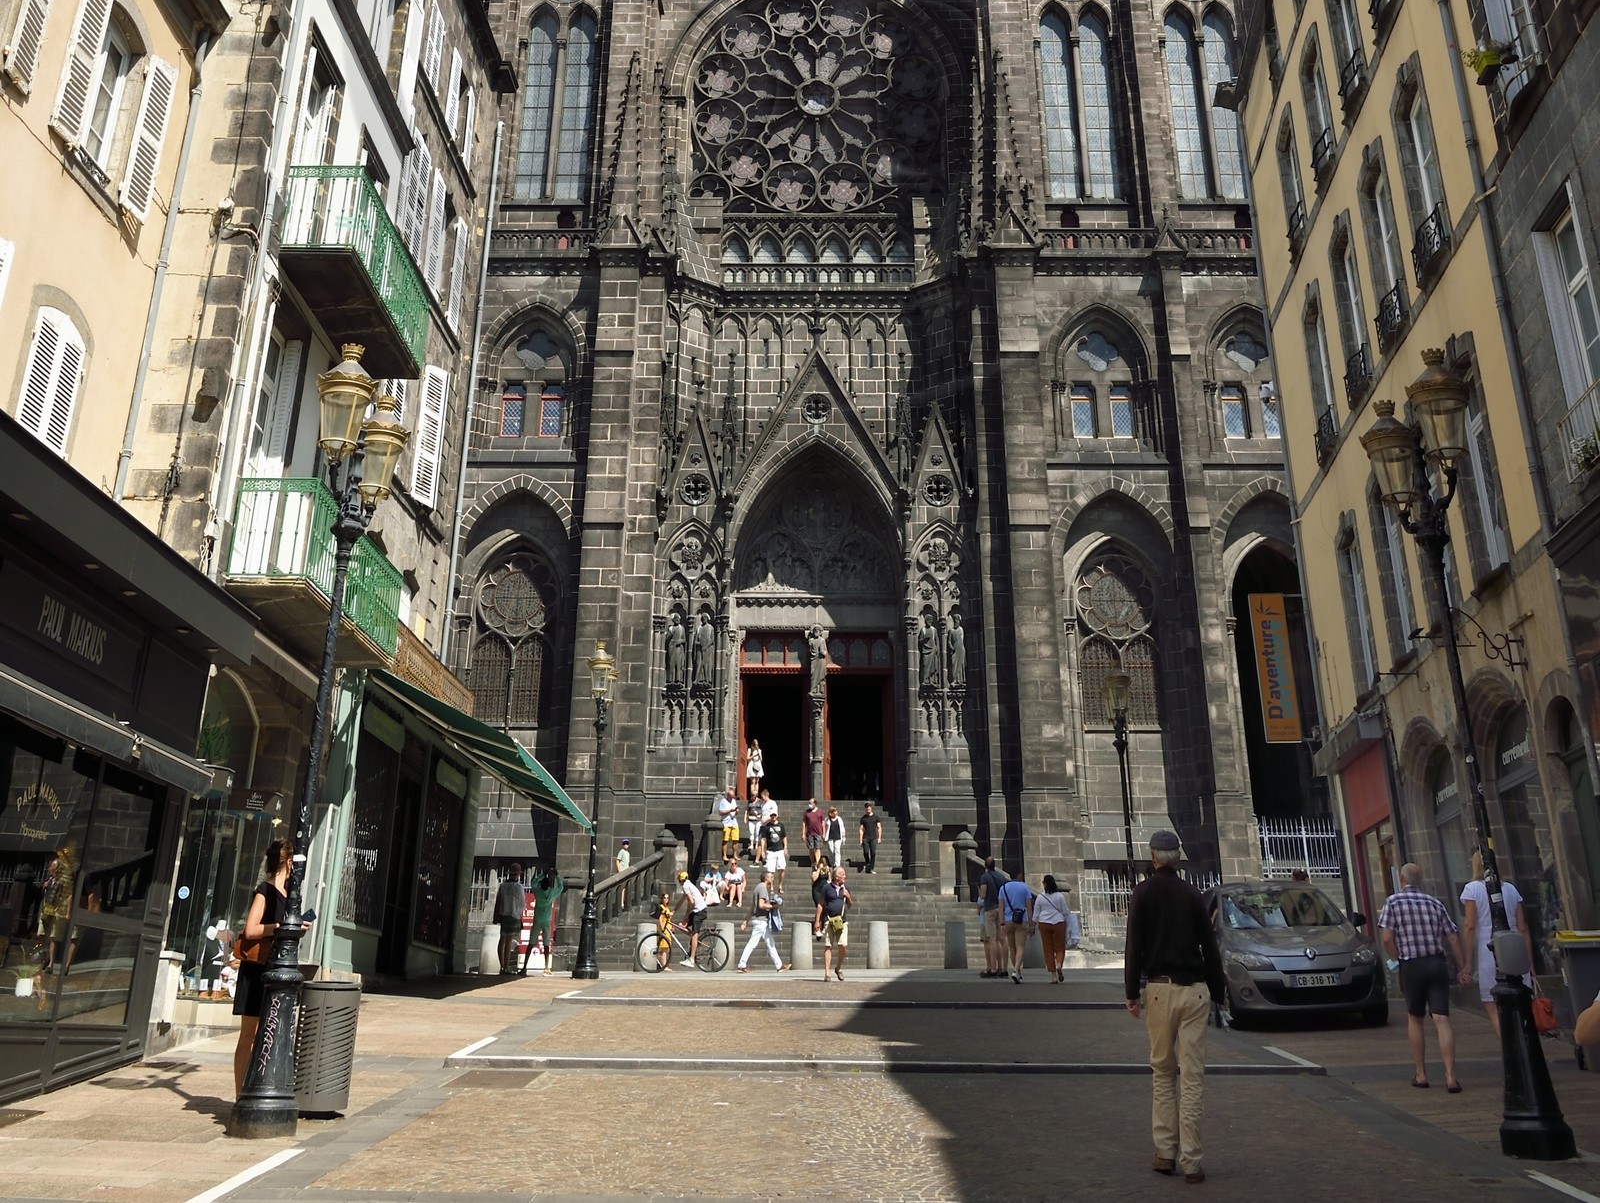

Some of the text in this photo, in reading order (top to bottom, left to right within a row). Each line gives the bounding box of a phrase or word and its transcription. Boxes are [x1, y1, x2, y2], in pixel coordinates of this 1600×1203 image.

[38, 595, 107, 665] PAUL MARIUS
[1261, 619, 1283, 719] D'aventure
[16, 782, 61, 819] PAUL MARIUS
[1298, 975, 1336, 986] CB-316-YX
